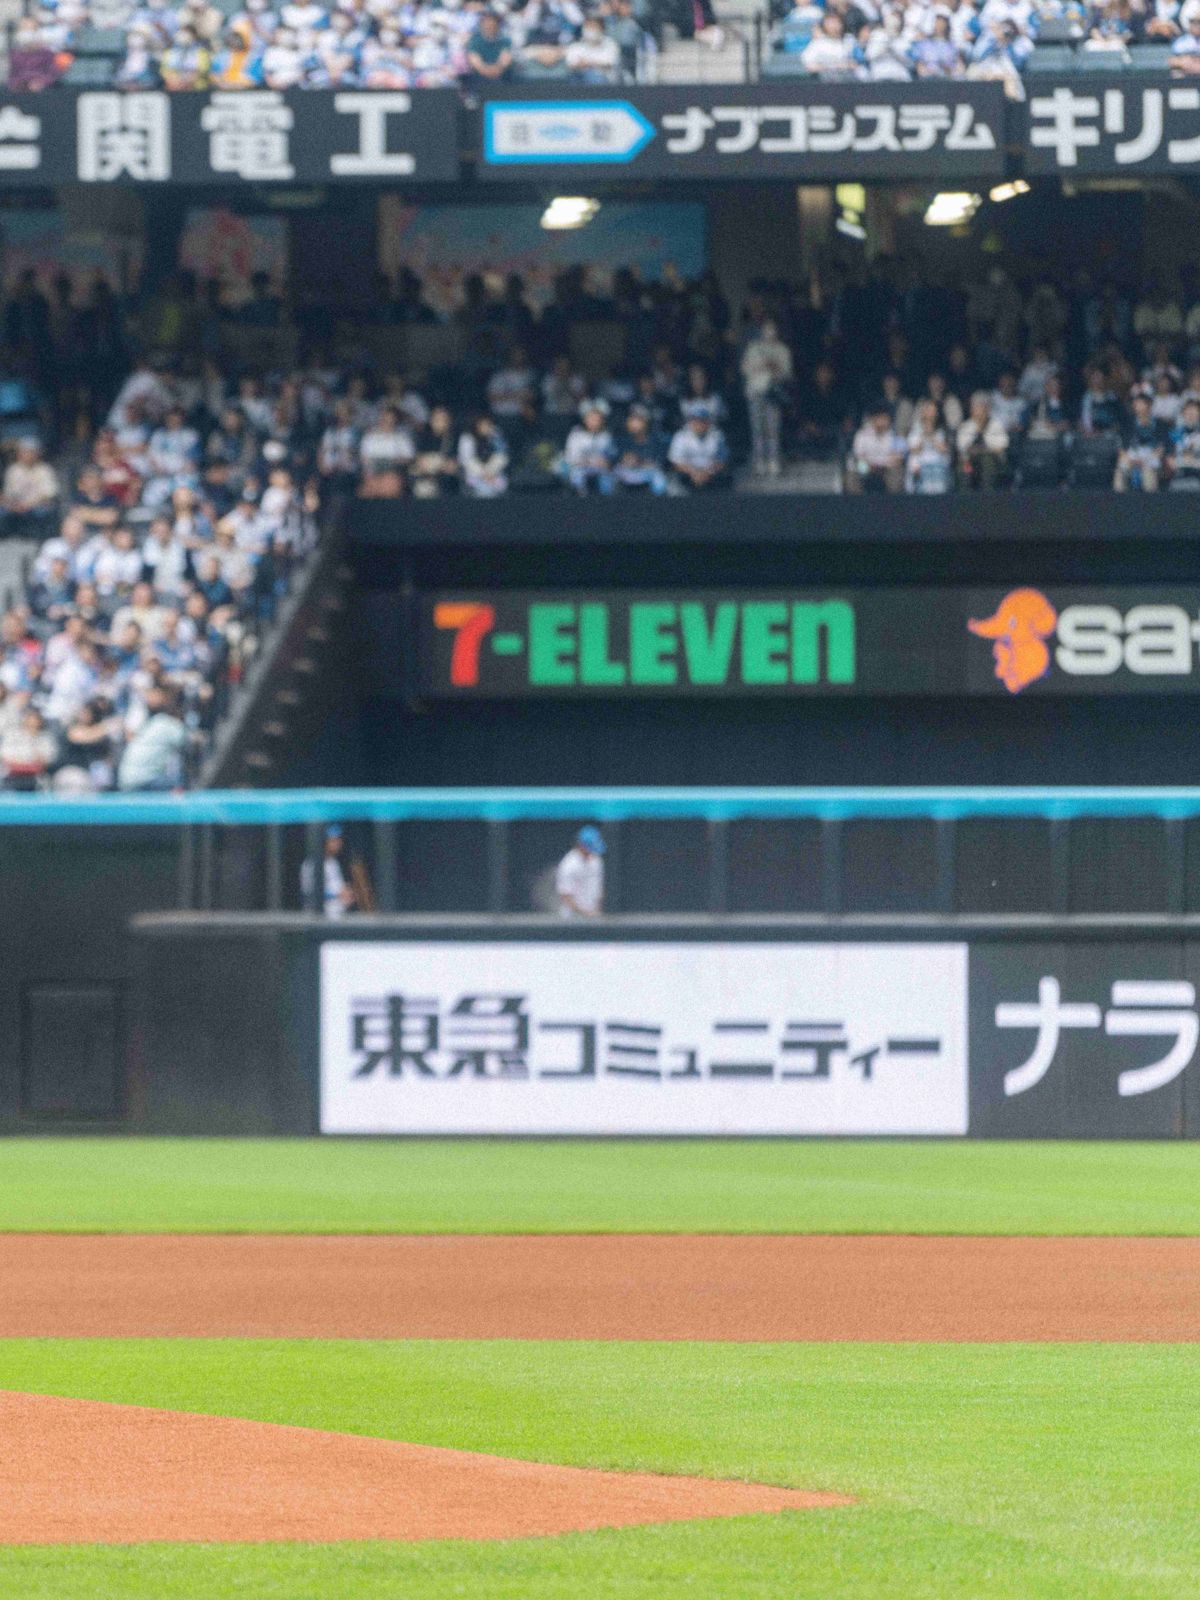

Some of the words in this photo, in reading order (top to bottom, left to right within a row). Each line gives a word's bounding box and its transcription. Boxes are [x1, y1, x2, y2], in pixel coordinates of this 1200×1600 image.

[77, 91, 416, 181] 関電工
[1055, 604, 1200, 675] sa
[350, 994, 941, 1082] 東急コミュニティー
[994, 975, 1199, 1097] ナラ
